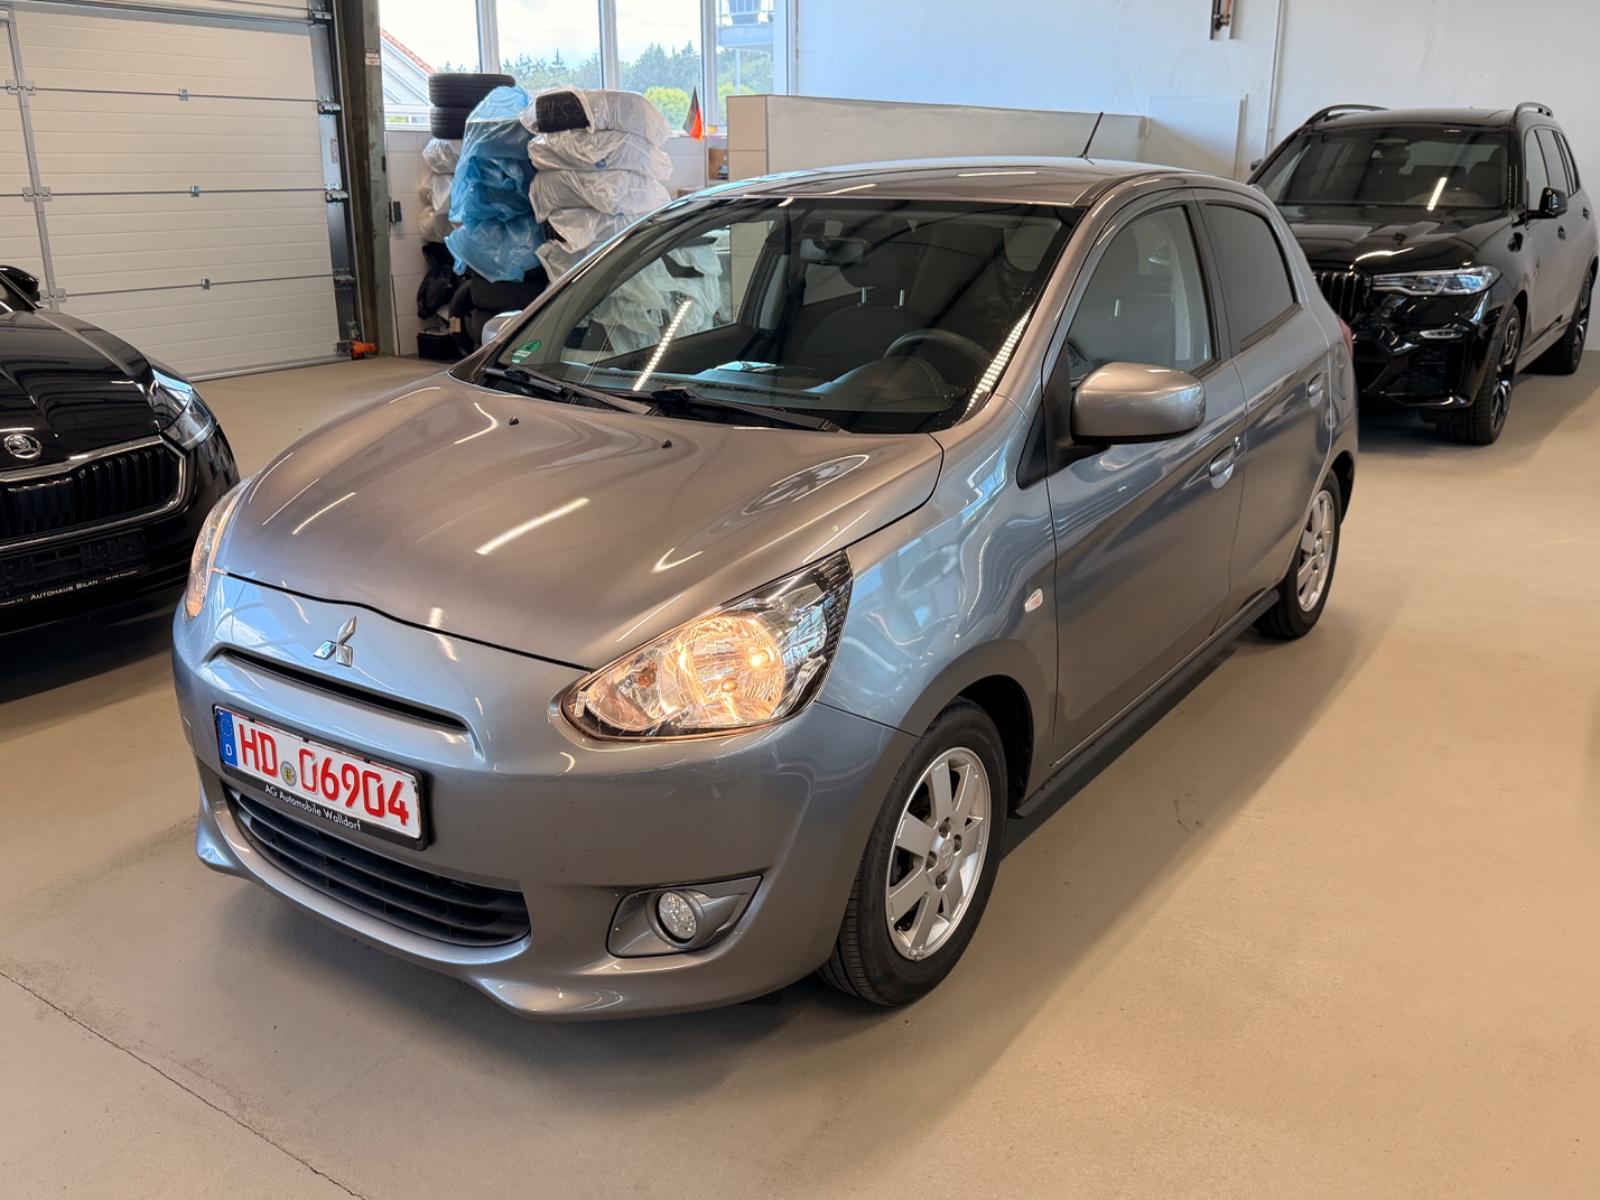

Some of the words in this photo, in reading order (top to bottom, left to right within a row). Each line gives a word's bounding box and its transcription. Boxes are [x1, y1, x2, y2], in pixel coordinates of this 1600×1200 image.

[225, 743, 233, 756] D
[238, 723, 278, 778] HD
[298, 748, 410, 826] 06904
[265, 784, 278, 798] AG
[279, 792, 323, 817] Automobile
[323, 809, 362, 832] Walldorf
